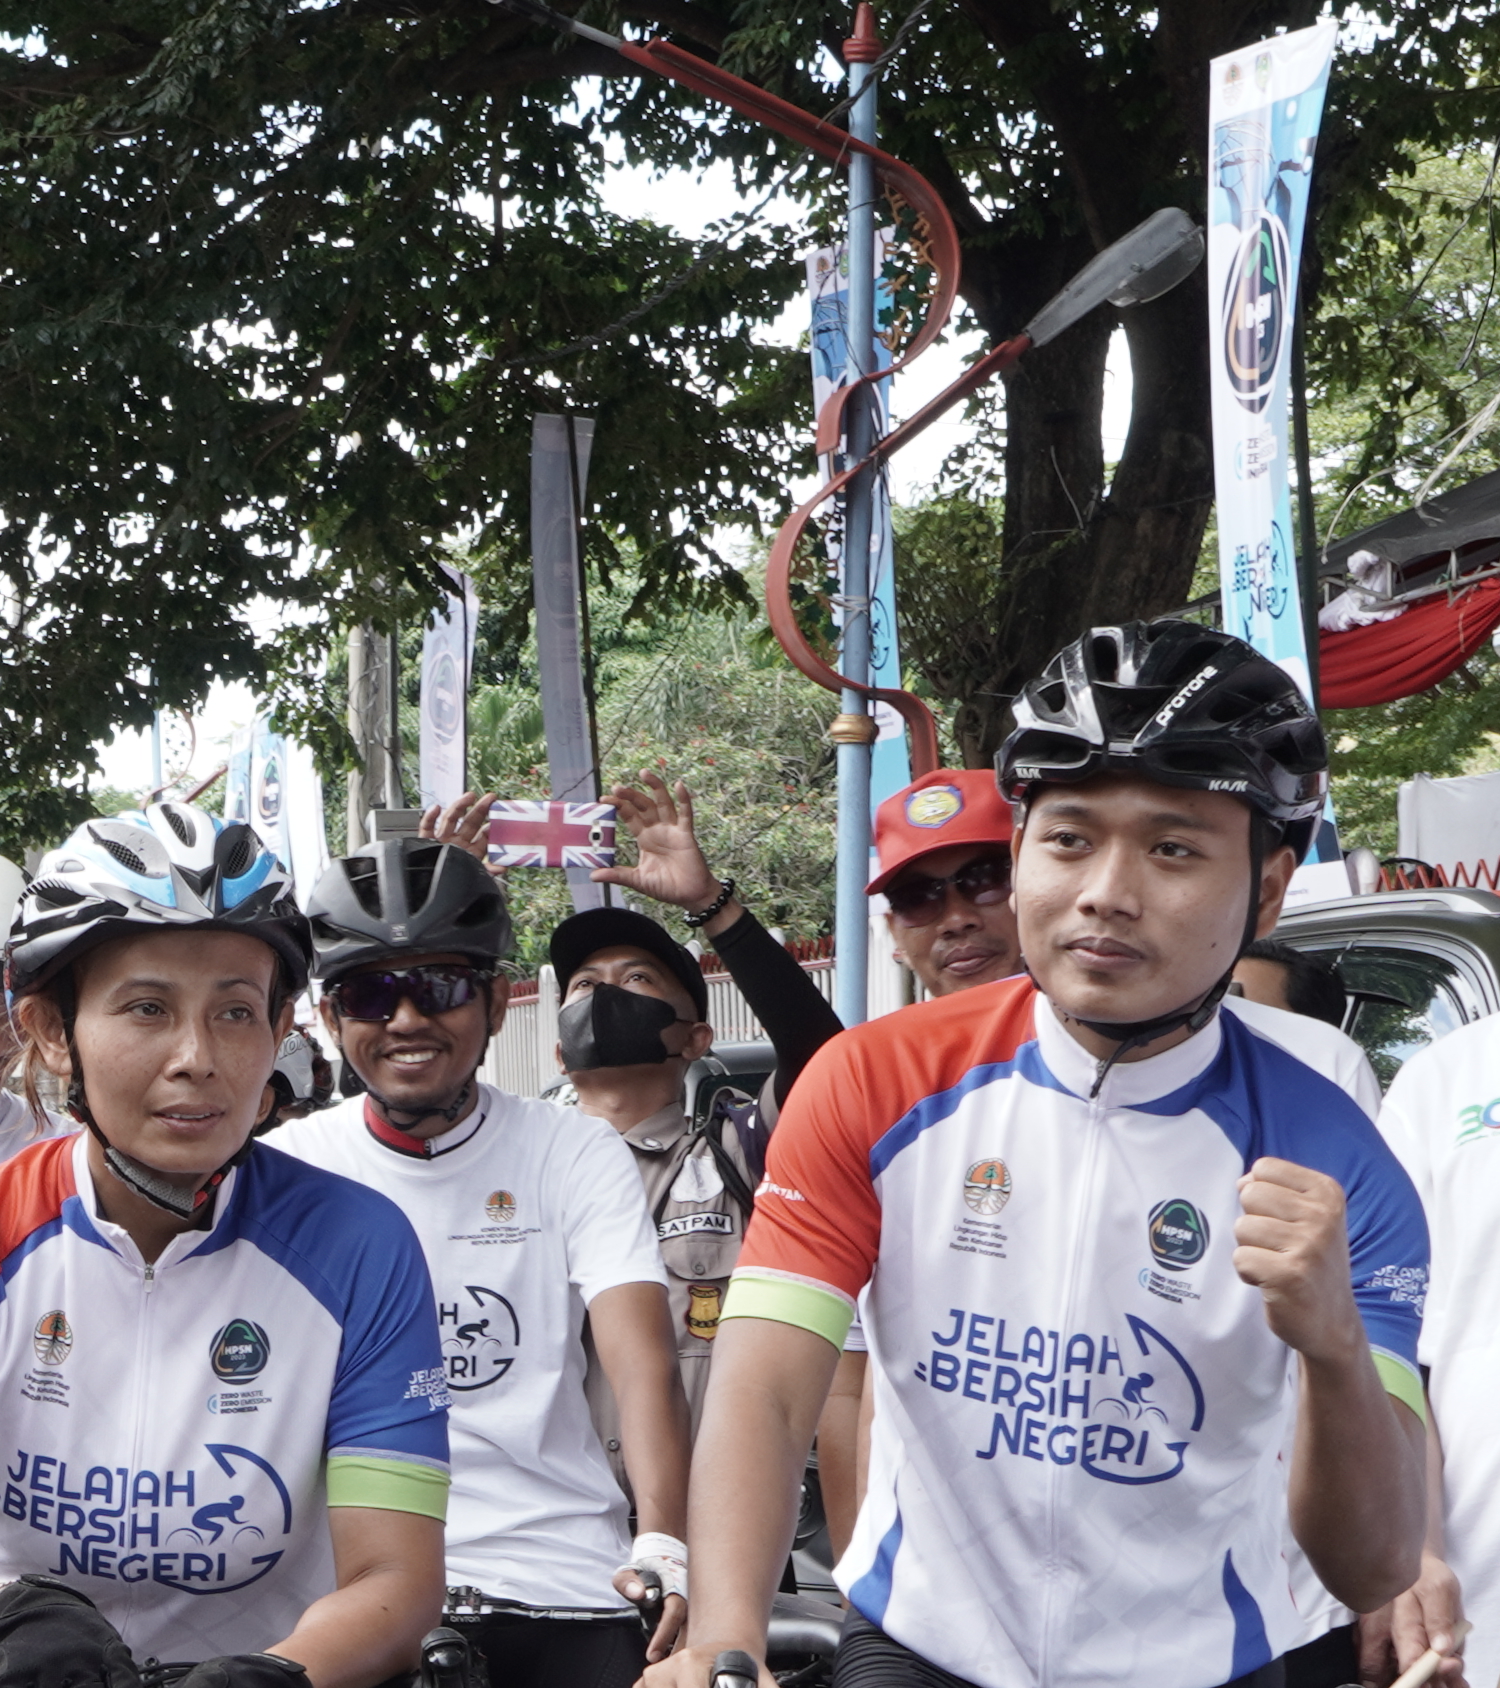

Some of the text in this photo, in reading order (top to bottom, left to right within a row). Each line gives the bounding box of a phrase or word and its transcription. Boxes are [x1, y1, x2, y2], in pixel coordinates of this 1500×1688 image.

[657, 1216, 726, 1236] SATPAM
[1161, 1224, 1193, 1241] HPSN
[224, 1344, 253, 1355] HPSN
[932, 1308, 1124, 1378] JELAJAH
[930, 1350, 1091, 1419] BERSIH
[975, 1412, 1149, 1465] NEGERI
[7, 1449, 195, 1509] JELAJAH
[3, 1482, 159, 1548] BERSIH
[48, 1543, 226, 1583] NEGERI
